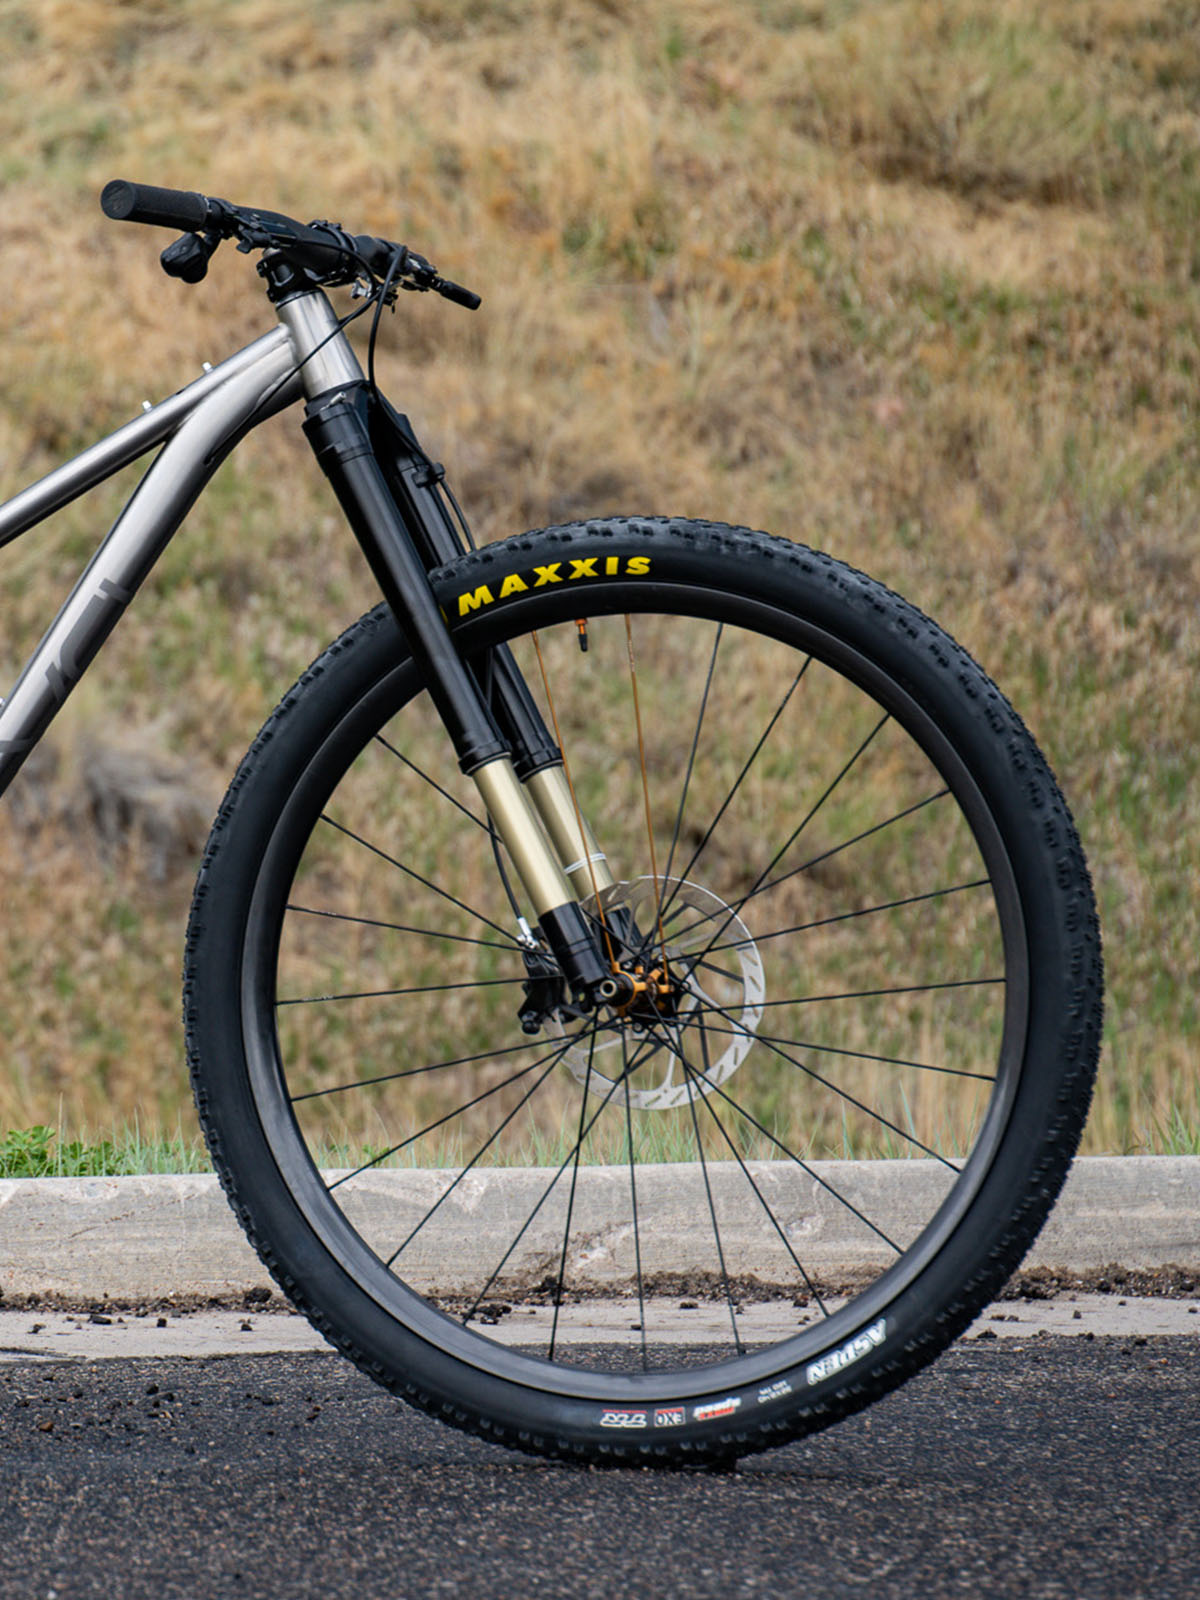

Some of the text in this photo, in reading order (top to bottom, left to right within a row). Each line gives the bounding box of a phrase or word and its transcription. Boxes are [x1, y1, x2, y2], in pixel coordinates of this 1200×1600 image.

[458, 556, 651, 617] MAXXIS
[806, 1318, 887, 1386] ASPEN
[656, 1411, 684, 1426] EXO
